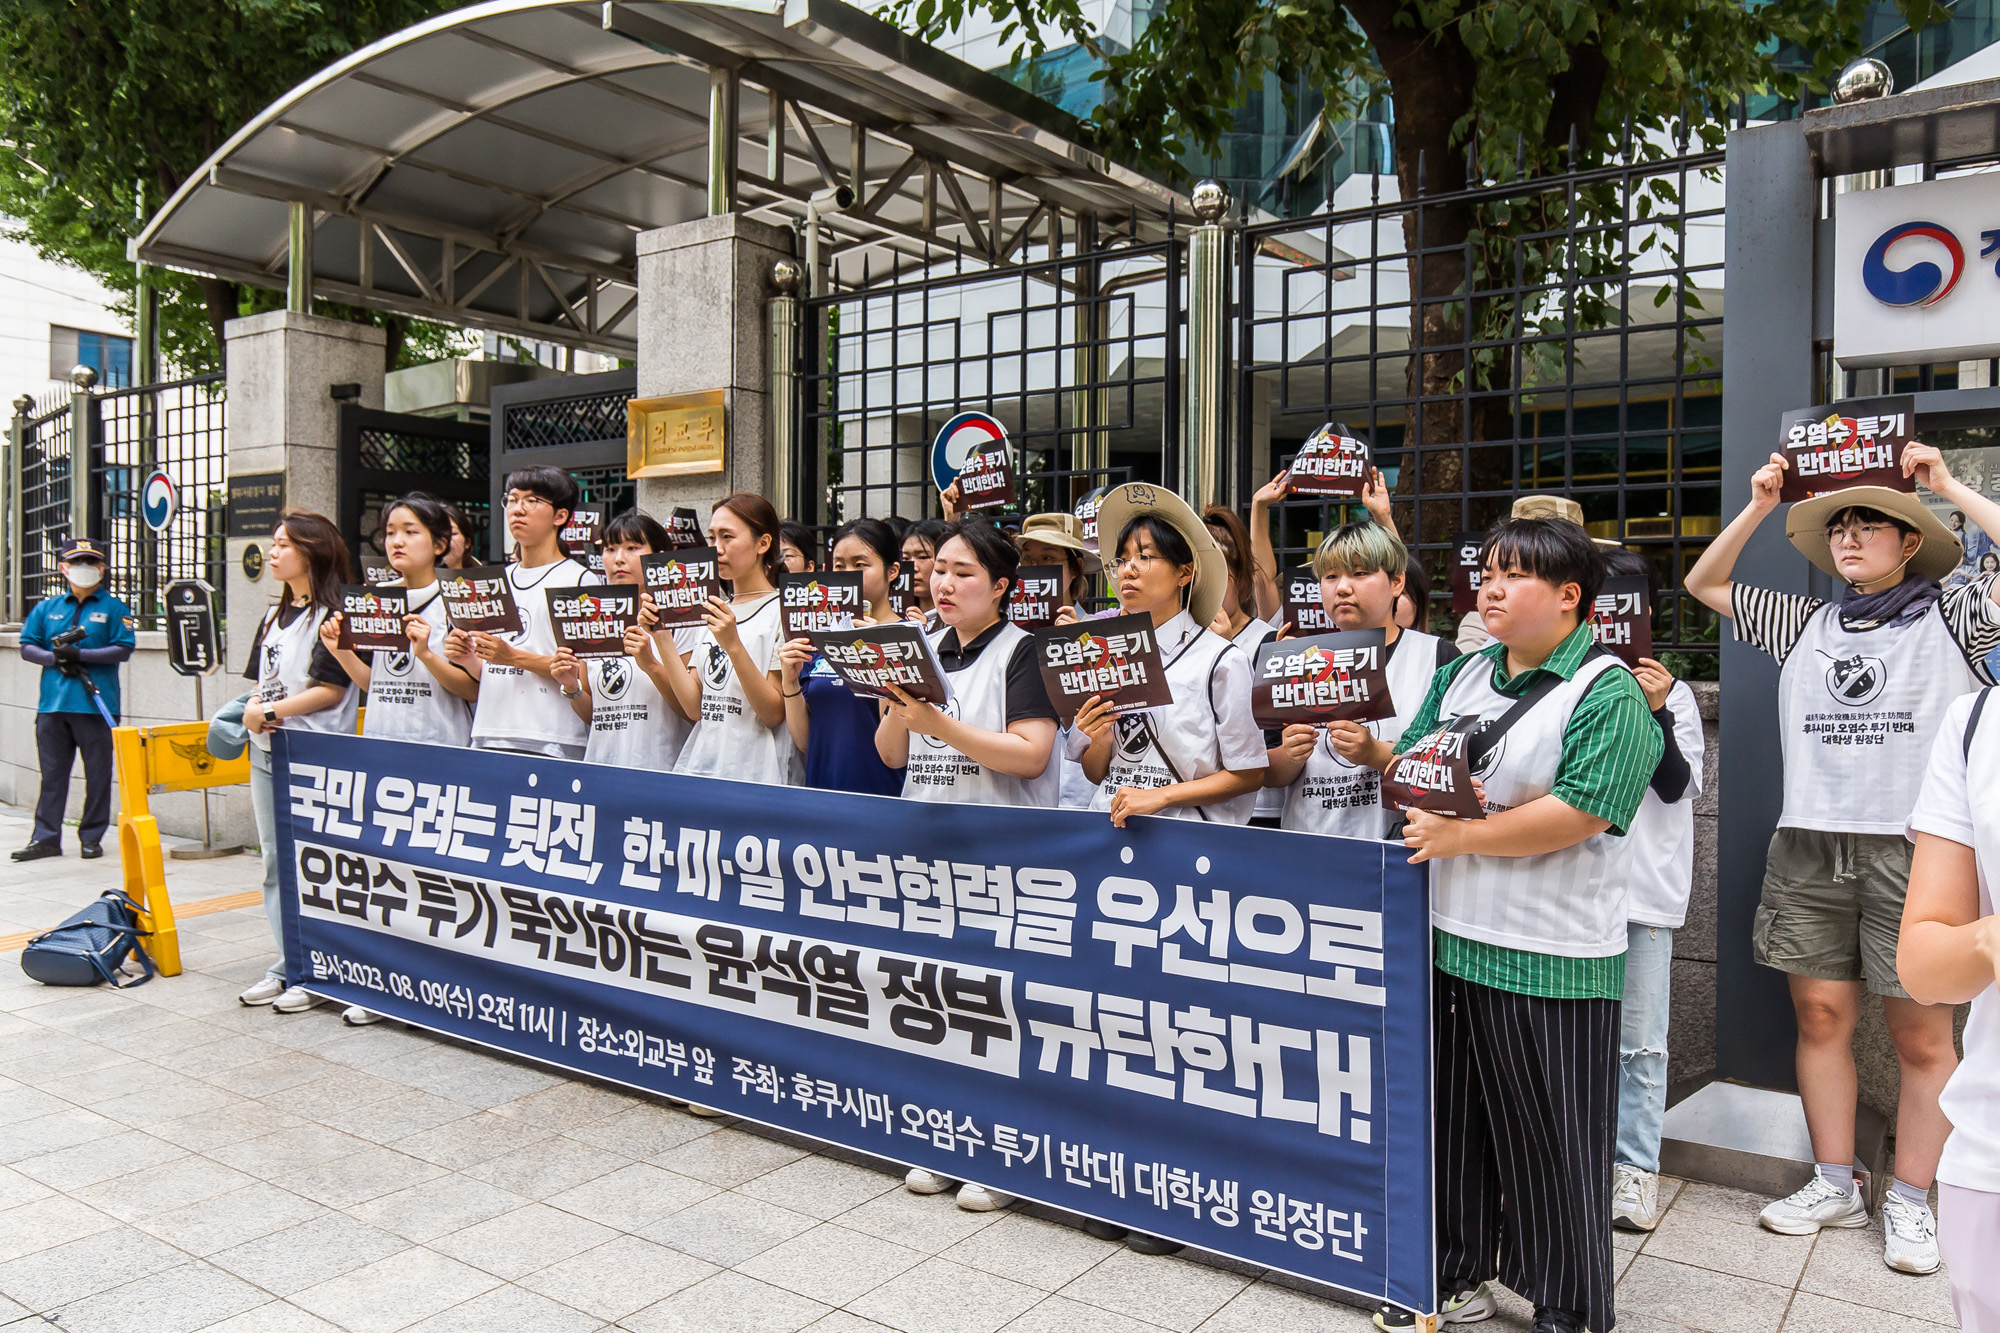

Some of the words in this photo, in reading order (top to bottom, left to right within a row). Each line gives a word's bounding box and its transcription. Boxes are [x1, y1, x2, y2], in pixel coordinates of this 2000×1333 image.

[1787, 421, 1850, 449] 오염수
[1856, 413, 1905, 440] 투기
[985, 449, 1007, 469] 투기
[1298, 436, 1336, 456] 염수
[1339, 437, 1368, 460] 투기
[1796, 444, 1894, 476] 반대한다!
[962, 471, 1006, 495] 반대한다!
[574, 511, 599, 525] 투기
[646, 564, 684, 586] 오염수
[686, 561, 715, 582] 투기
[440, 580, 472, 598] 오염수
[474, 577, 507, 596] 투기
[654, 586, 708, 610] 반대한다!
[784, 586, 825, 607] 오염수
[827, 585, 858, 606] 투기
[1024, 578, 1057, 597] 투기
[344, 596, 379, 613] 오염수
[380, 598, 405, 614] 투기
[448, 599, 505, 619] 반대한다!
[553, 599, 594, 618] 오염수
[600, 597, 633, 616] 투기
[1595, 592, 1641, 615] 투기
[350, 616, 401, 634] 반대한다!
[562, 619, 625, 640] 반대한다!
[824, 644, 880, 664] 오염수
[881, 641, 923, 662] 투기
[1046, 638, 1102, 668] 오염수
[1105, 630, 1151, 659] 투기
[1263, 653, 1327, 679] 오염수
[1332, 646, 1378, 671] 투기
[843, 666, 925, 687] 반대한다!
[1059, 661, 1148, 695] 반대한다!
[1272, 678, 1370, 708] 반대한다!
[1837, 723, 1868, 733] 오염수
[1870, 722, 1889, 733] 투기
[1892, 722, 1915, 733] 반대
[1437, 732, 1466, 759] 투기
[1822, 734, 1852, 745] 대학생
[1854, 733, 1885, 745] 원정단
[924, 764, 943, 773] 오염수
[945, 765, 959, 774] 투기
[961, 765, 980, 775] 반대
[932, 775, 955, 786] 원정단
[1132, 775, 1151, 786] 투기
[1394, 758, 1455, 793] 반대한다!
[1337, 783, 1362, 796] 오염수
[1322, 797, 1347, 810] 대학생
[1350, 793, 1378, 807] 원정단
[289, 762, 367, 840] 국민
[373, 776, 496, 863] 우려는
[501, 794, 603, 885] 뒷전,
[793, 843, 1077, 957] 안보협력을
[1092, 875, 1386, 1007] 우선으로
[300, 846, 408, 927] 오염수
[412, 869, 498, 948] 투기
[500, 886, 692, 990] 묵인하는
[695, 924, 869, 1030] 윤석열
[877, 956, 1013, 1058] 정부
[1025, 981, 1371, 1144] 규탄한다!
[389, 972, 419, 1002] 08.
[420, 979, 473, 1020] 09(수)
[478, 993, 514, 1031] 오전
[519, 1003, 554, 1043] 11시
[577, 1016, 688, 1076] 장소:외교부
[692, 1046, 715, 1085] 앞
[732, 1056, 786, 1103] 주최:
[791, 1072, 894, 1135] 후쿠시마
[901, 1103, 985, 1157] 오염수
[992, 1124, 1051, 1179] 투기
[1061, 1141, 1126, 1199] 반대
[1134, 1162, 1239, 1228] 대학생
[1249, 1189, 1368, 1262] 원정단
